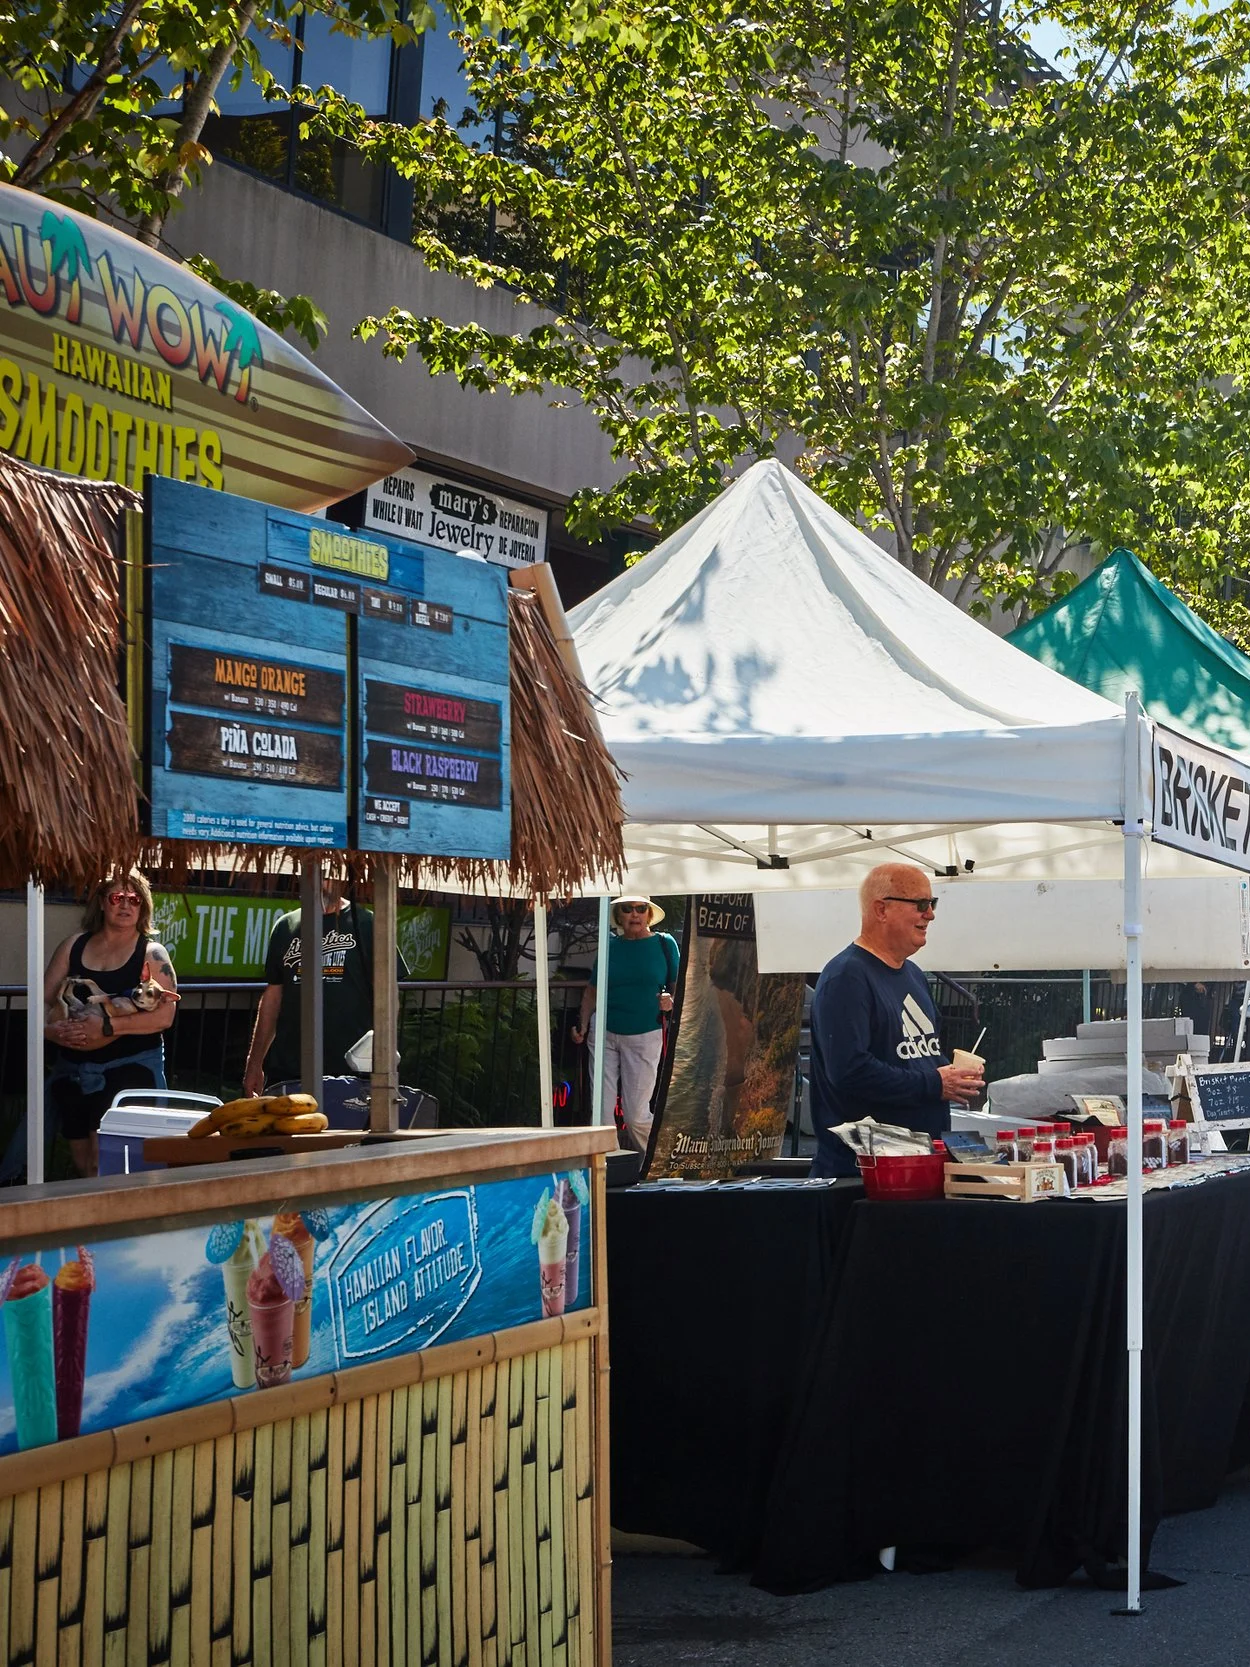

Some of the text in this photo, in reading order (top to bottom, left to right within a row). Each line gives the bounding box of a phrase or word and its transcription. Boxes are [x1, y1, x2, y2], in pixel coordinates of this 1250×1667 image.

[53, 333, 173, 410] HAWAIIAN
[0, 357, 223, 492] SMOOTHIES
[383, 476, 415, 501] REPAIRS
[373, 499, 424, 531] WHILE U WAIT
[438, 489, 490, 522] mary's
[428, 511, 494, 559] Jewelry
[499, 536, 536, 563] DE JOYERIA
[310, 527, 389, 581] SMOOTHIES
[264, 572, 283, 587] SMALL
[314, 583, 339, 598] REGULAR
[215, 658, 305, 697] MANGO ORANGE
[404, 692, 466, 724] STRAWBERRY
[220, 723, 297, 761] PIÑA COLADA
[391, 749, 479, 782] BLACK RASPBERRY
[194, 905, 238, 964] THE
[698, 906, 749, 931] BEAT OF
[1199, 1076, 1227, 1086] Brisket
[670, 1132, 708, 1159] Marin
[343, 1246, 401, 1307] HAWAIIAN
[362, 1280, 409, 1336] ISLAND
